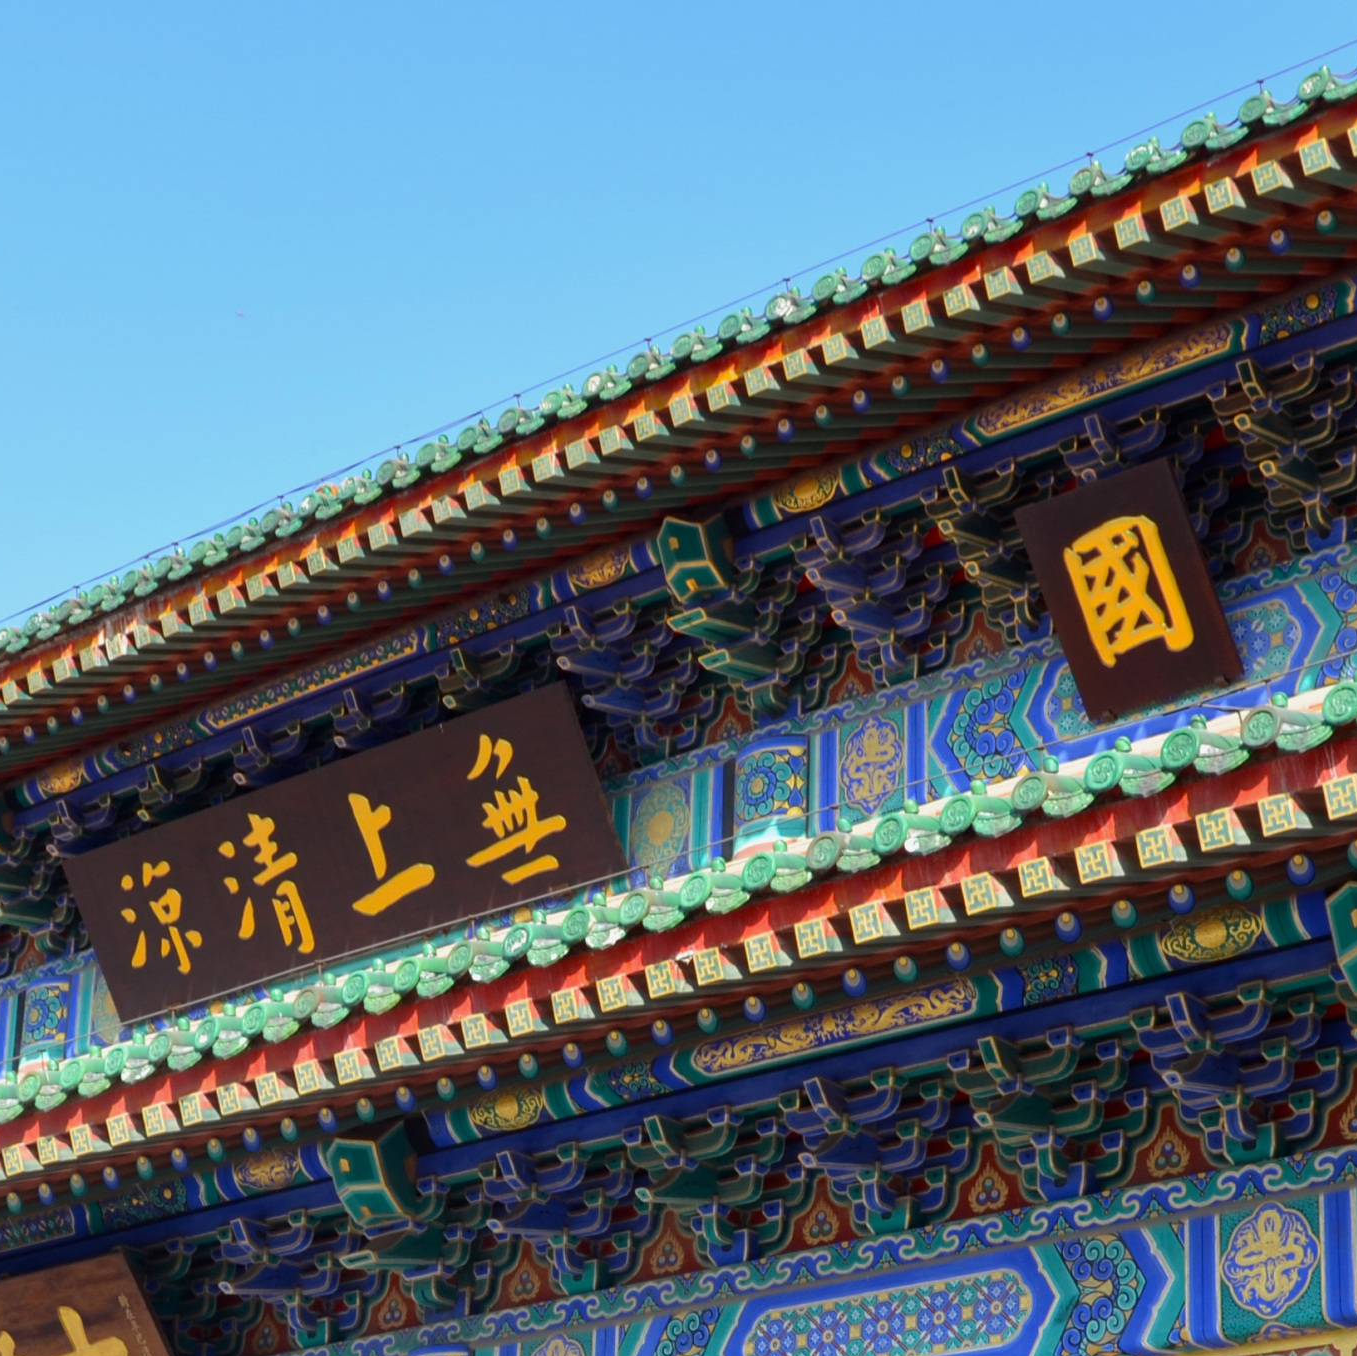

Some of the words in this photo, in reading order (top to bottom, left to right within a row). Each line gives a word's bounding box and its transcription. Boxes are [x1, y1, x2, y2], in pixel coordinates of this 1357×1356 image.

[1063, 515, 1194, 668] 國
[120, 733, 567, 975] 無上清涼
